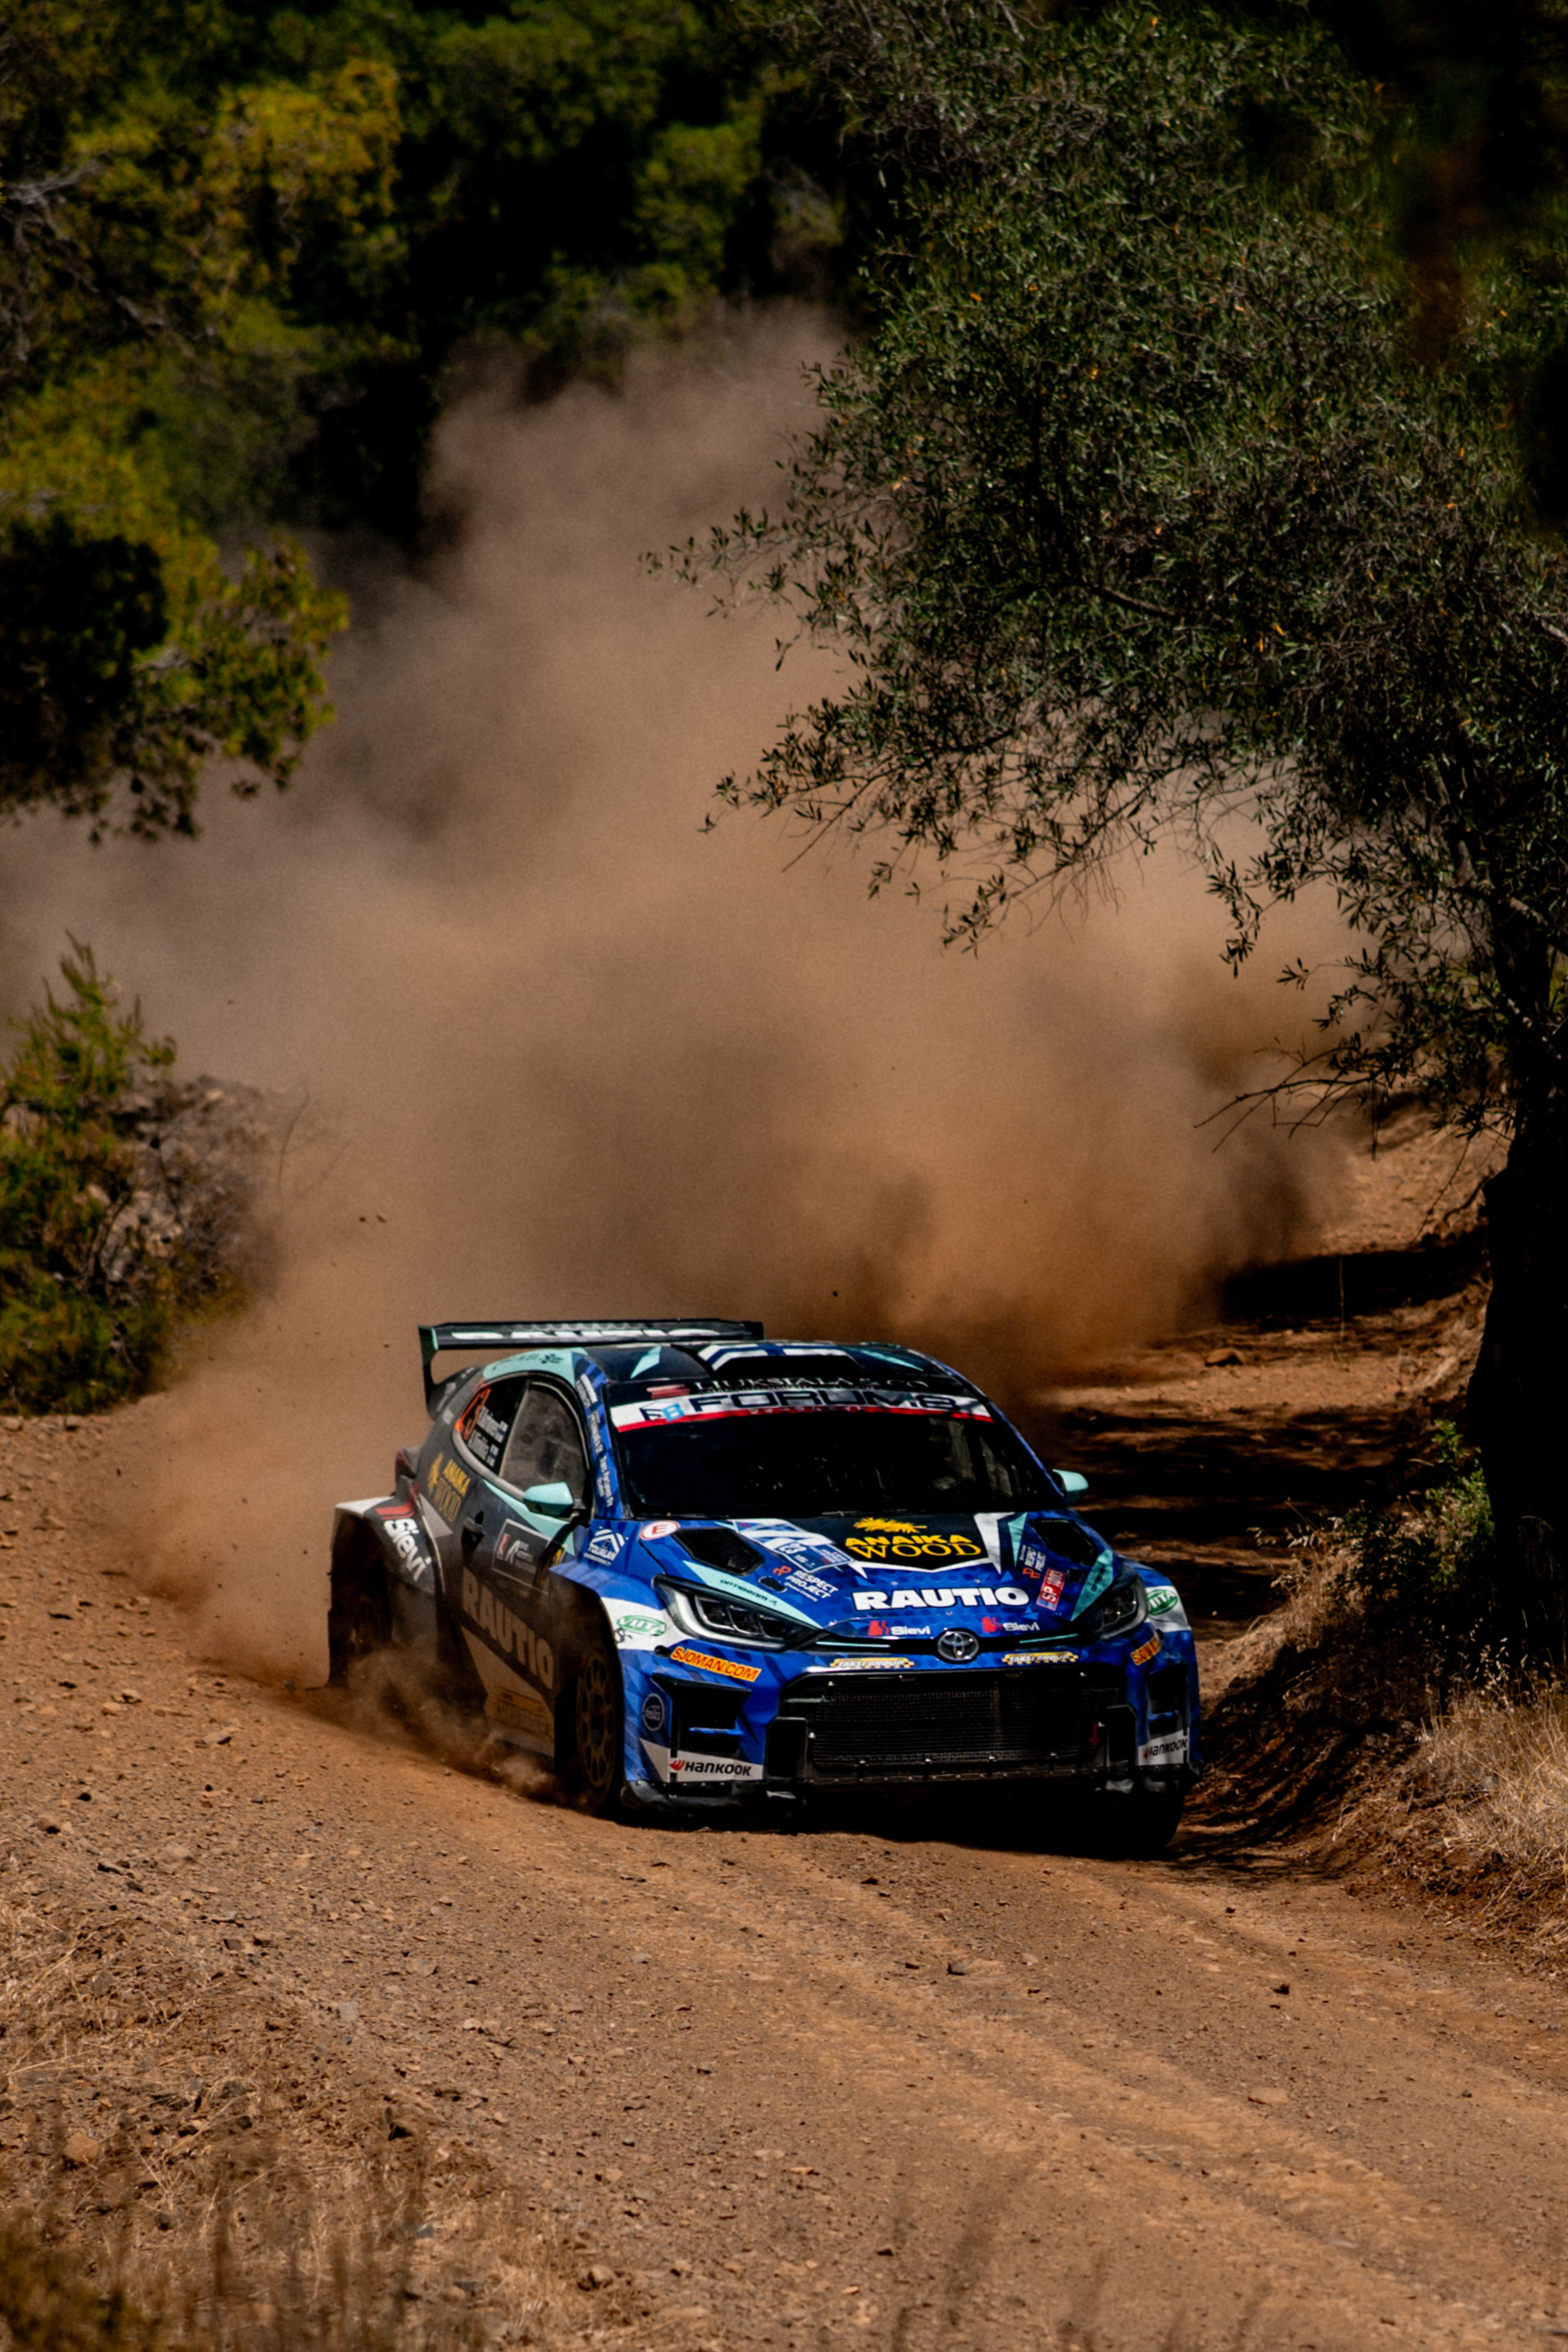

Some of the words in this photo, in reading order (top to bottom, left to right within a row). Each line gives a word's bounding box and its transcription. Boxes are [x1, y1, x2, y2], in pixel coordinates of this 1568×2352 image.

[443, 1460, 471, 1497] ANAIKA
[433, 1477, 461, 1523] WOOD
[652, 1525, 668, 1536] E
[845, 1534, 972, 1547] ANAIKA
[778, 1542, 808, 1555] 23
[848, 1543, 981, 1559] WOOD
[785, 1574, 832, 1599] PROJECT
[792, 1570, 839, 1594] RESPECT
[1041, 1585, 1058, 1603] SP
[852, 1586, 1030, 1611] RAUTIO
[462, 1565, 555, 1690] RAUTIO
